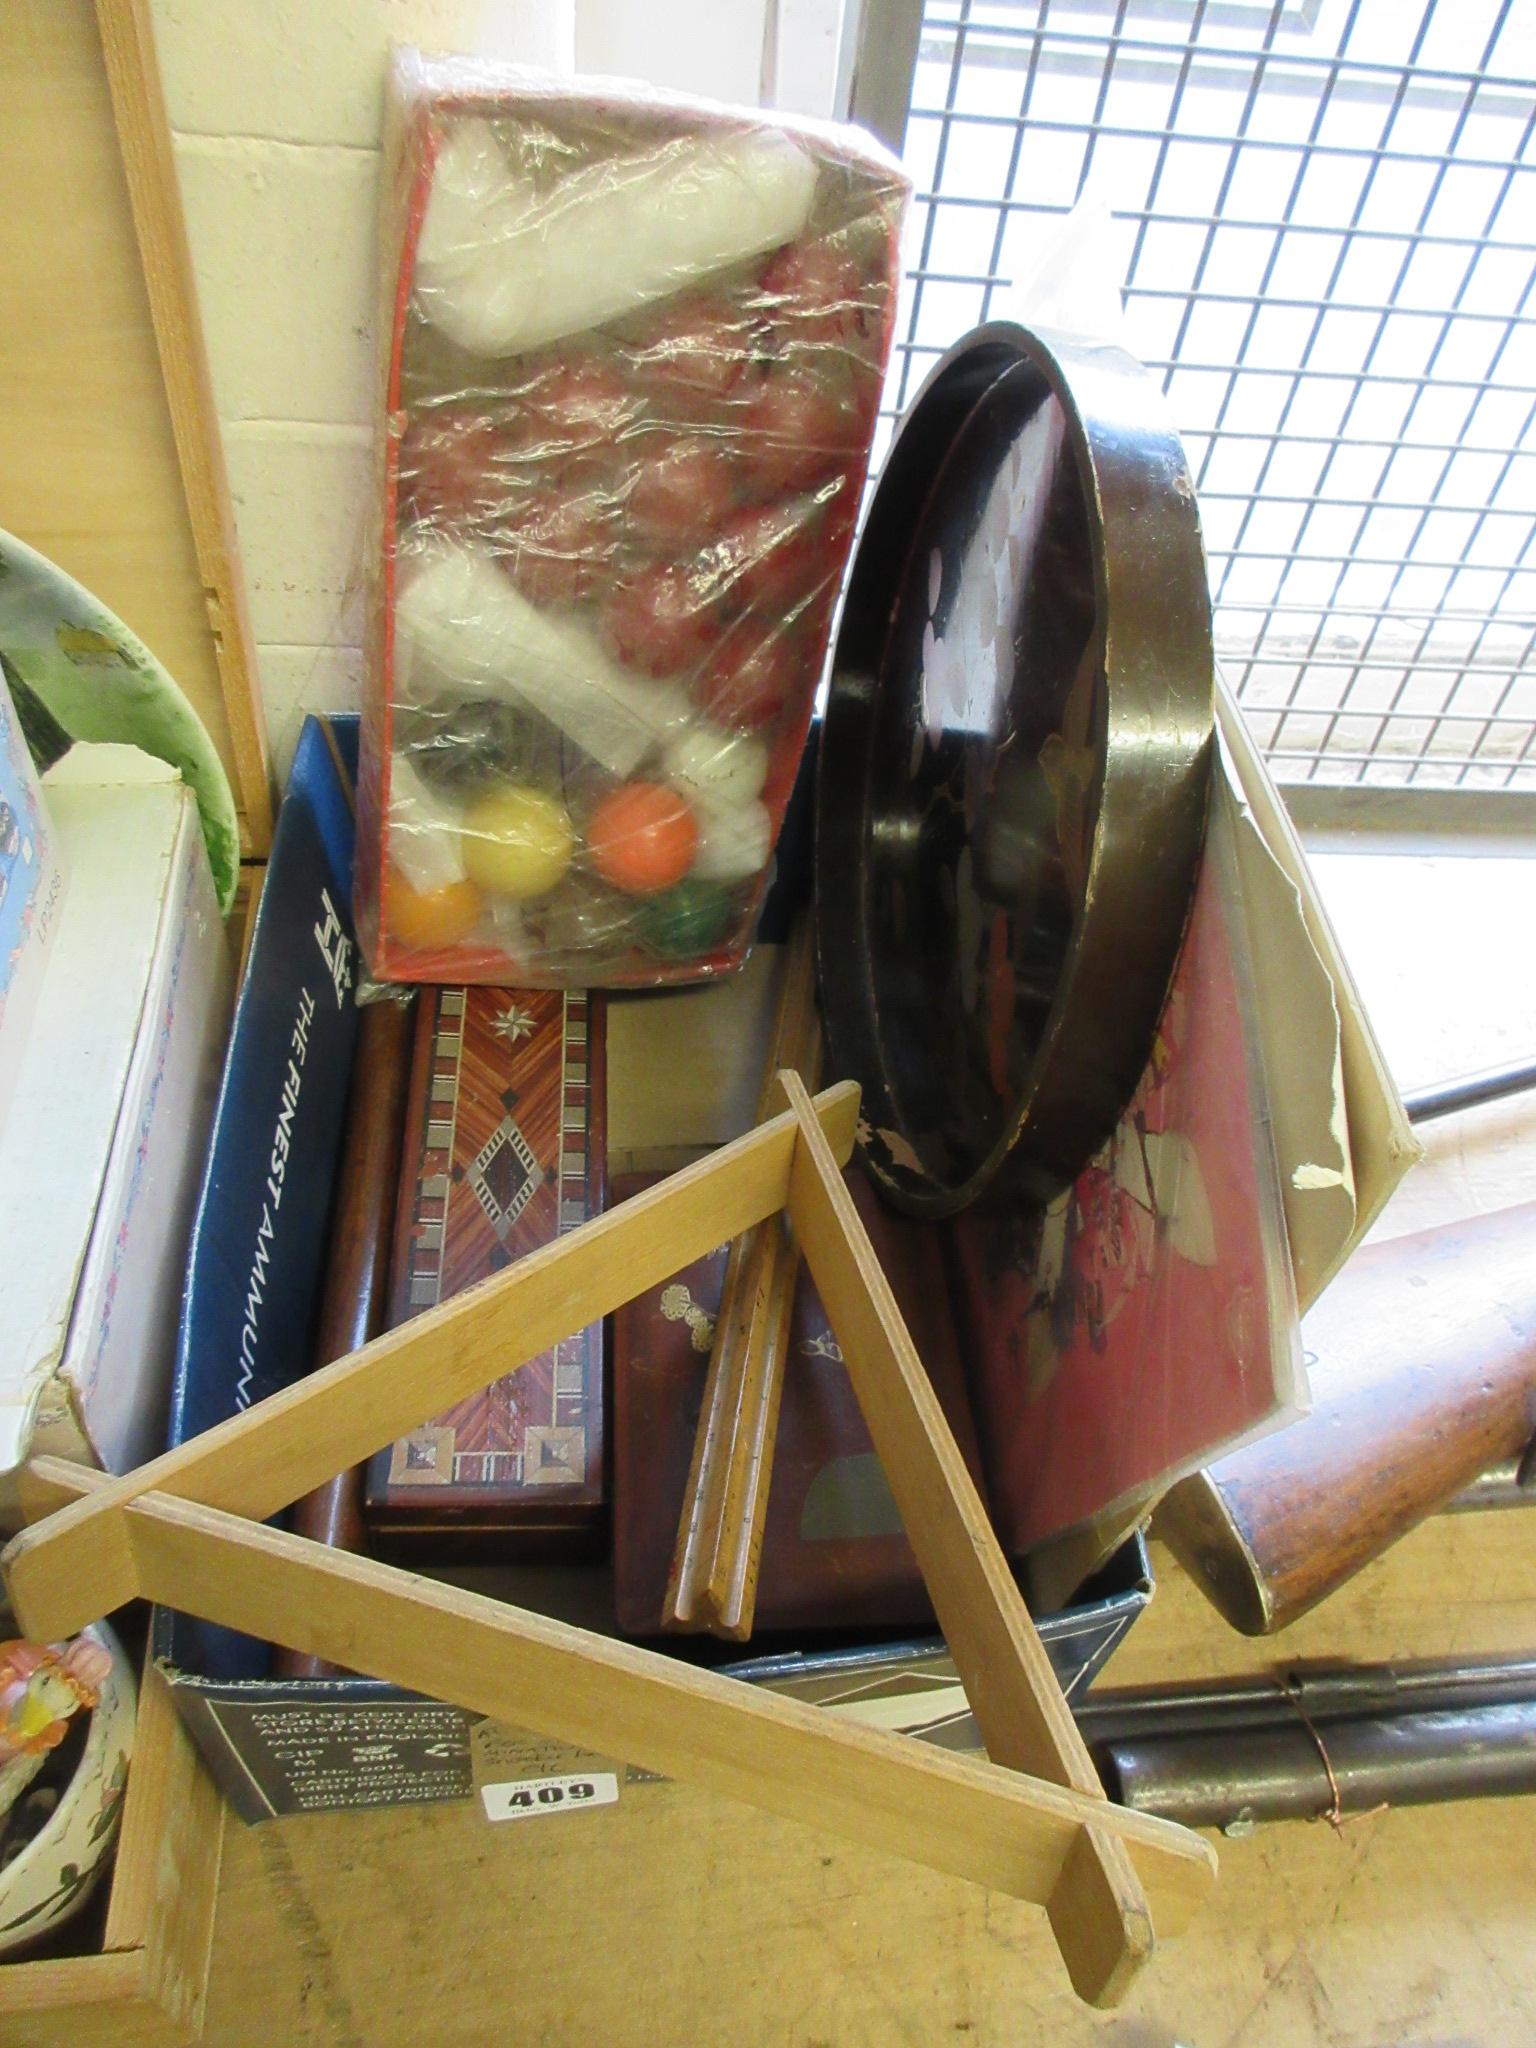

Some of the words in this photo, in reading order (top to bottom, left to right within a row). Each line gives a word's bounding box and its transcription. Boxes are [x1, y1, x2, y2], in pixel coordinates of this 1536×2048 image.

[292, 987, 315, 1066] THE
[267, 1059, 301, 1210] FINEST
[235, 1203, 274, 1412] AMMUNI
[252, 1712, 311, 1720] MUST
[255, 1719, 326, 1728] STORE
[334, 1718, 436, 1726] BETWEEN
[260, 1727, 309, 1736] AND
[266, 1737, 330, 1747] MADE
[508, 1783, 595, 1808] 409
